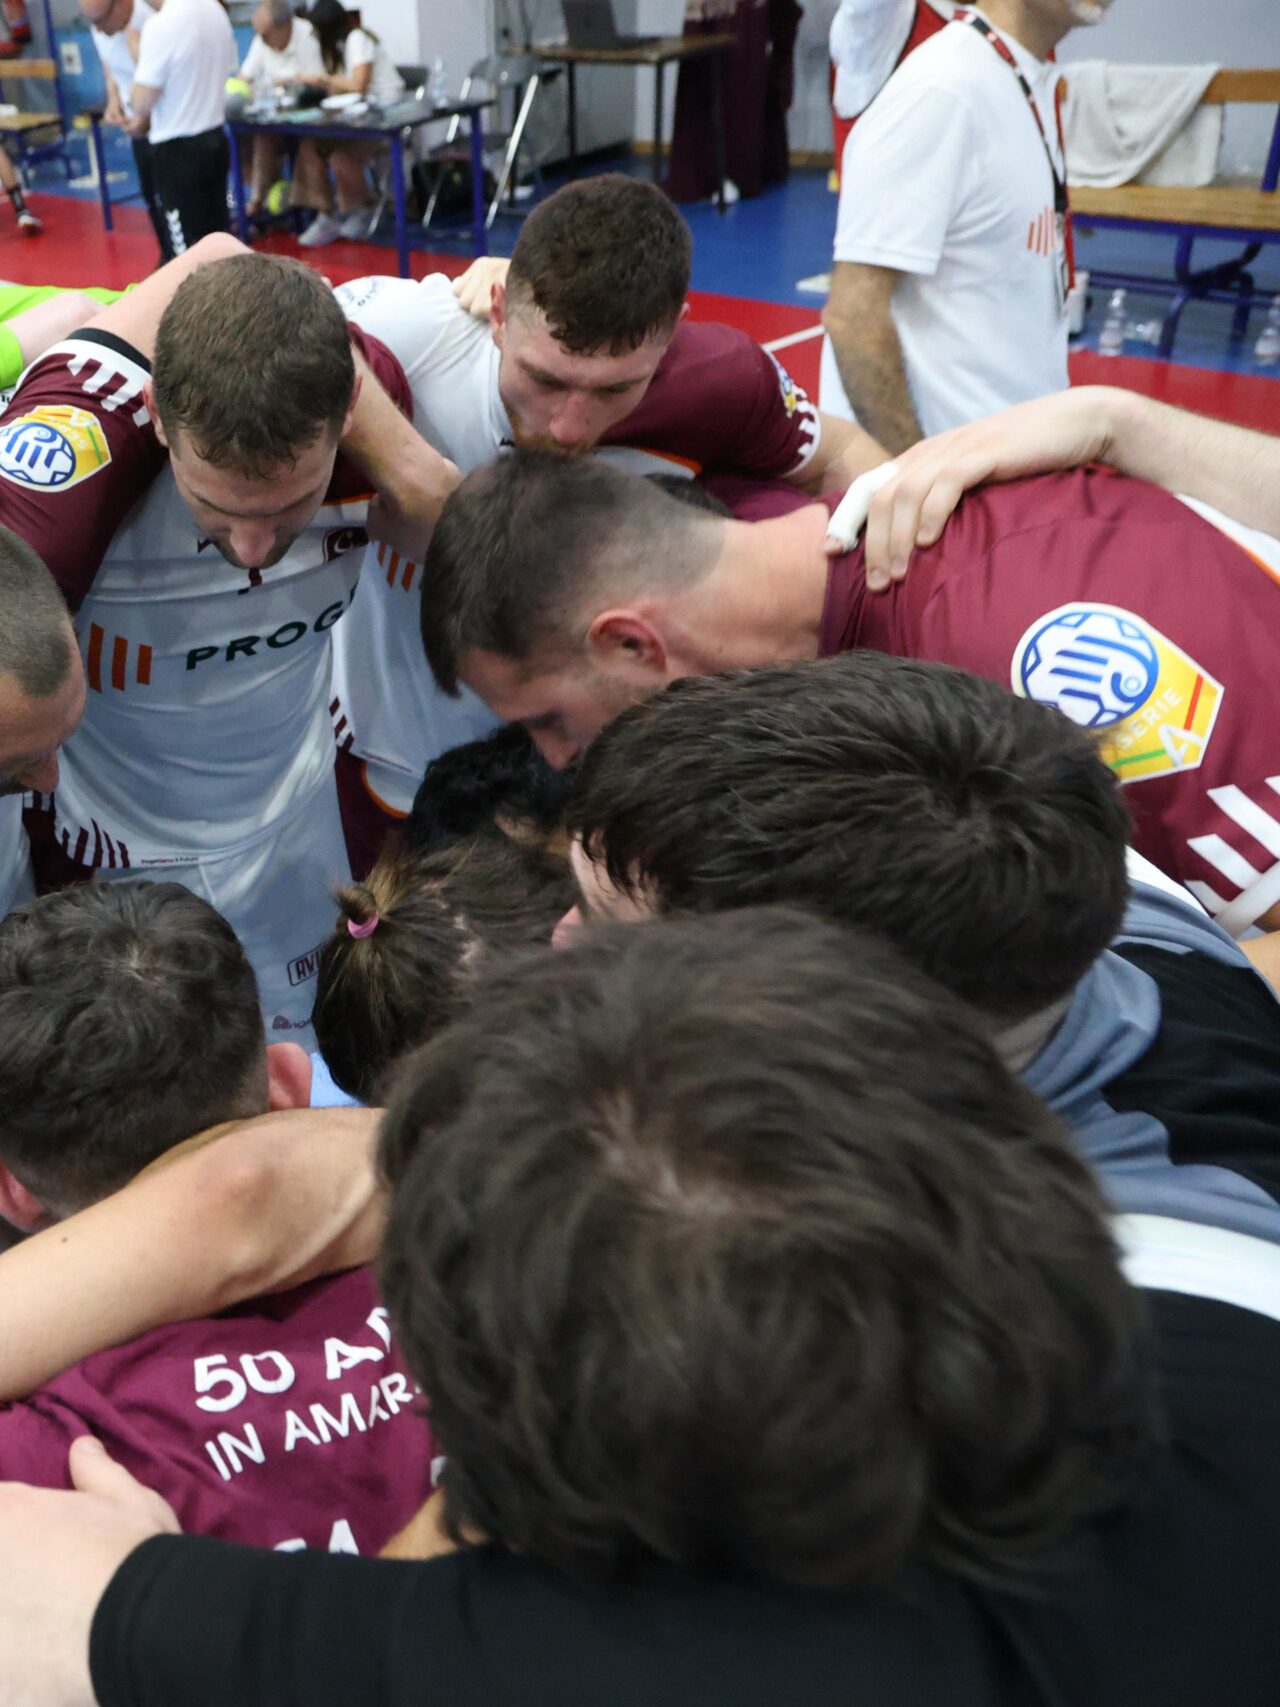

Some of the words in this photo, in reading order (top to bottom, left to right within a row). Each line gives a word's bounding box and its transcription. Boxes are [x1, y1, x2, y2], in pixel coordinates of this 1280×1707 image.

[186, 584, 356, 671] PROG
[1116, 687, 1184, 750] SERIE
[295, 950, 320, 980] AVI
[193, 1350, 296, 1412] 50
[205, 1422, 266, 1481] IN
[284, 1371, 422, 1452] AMAR
